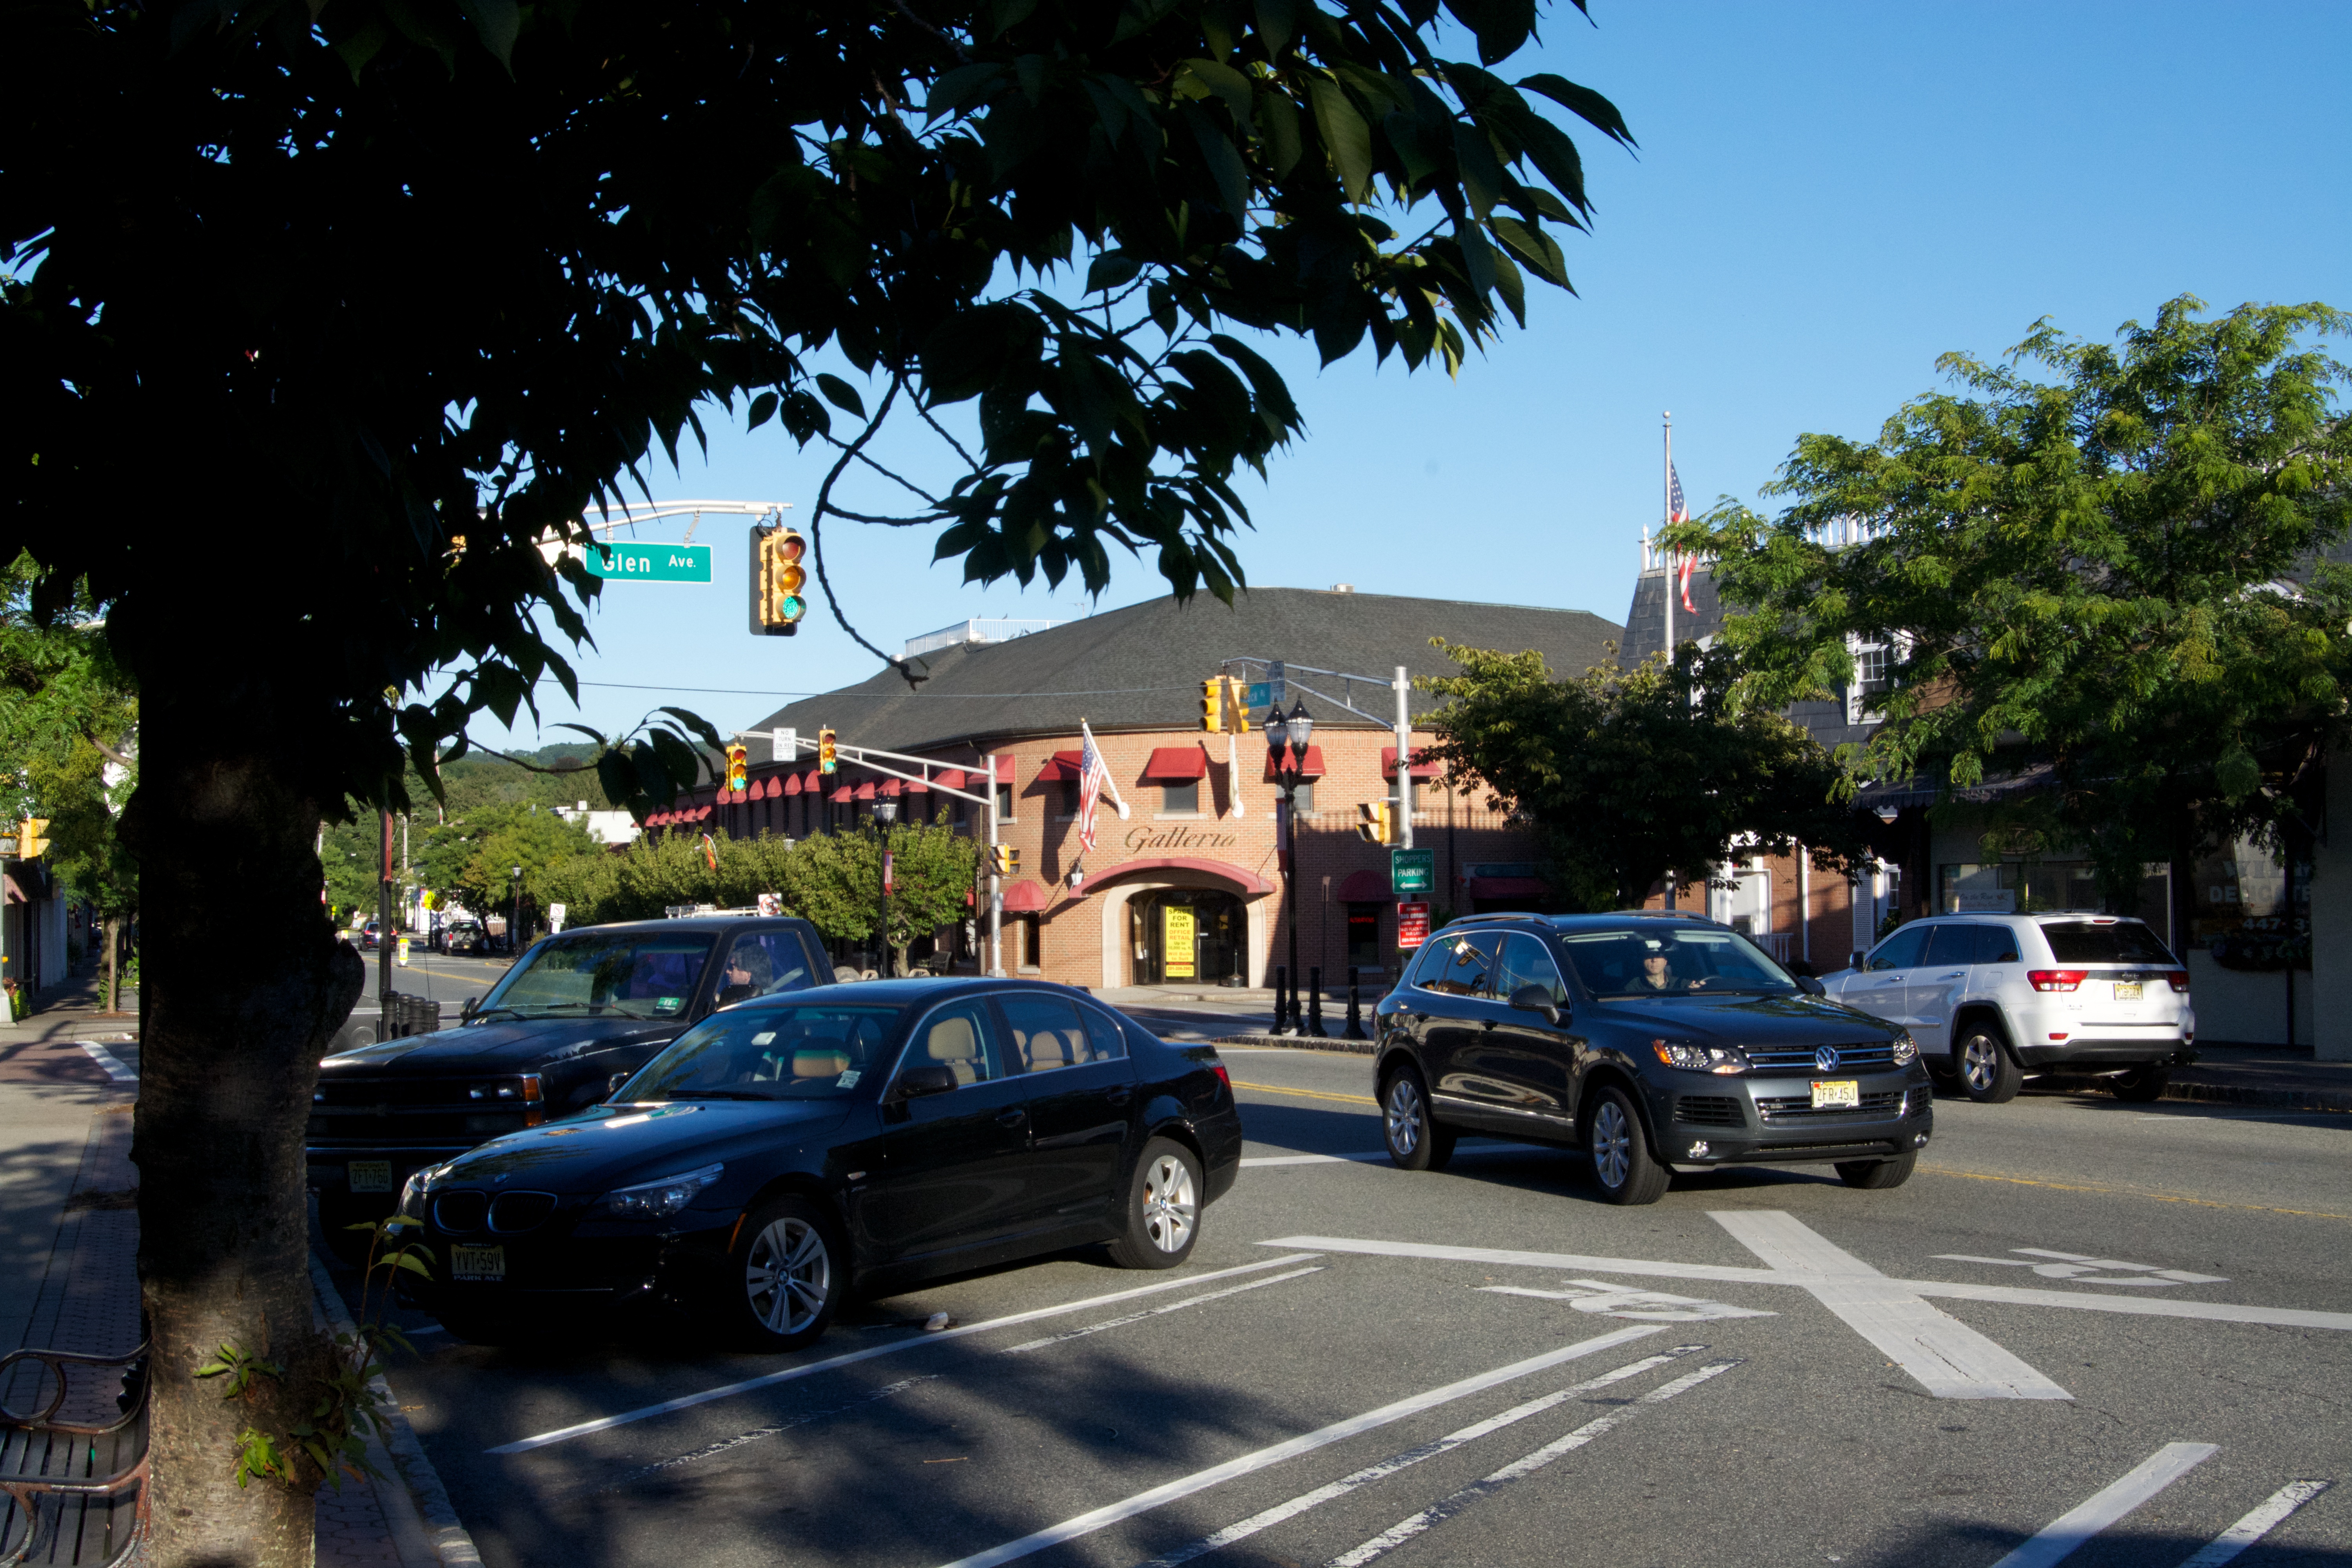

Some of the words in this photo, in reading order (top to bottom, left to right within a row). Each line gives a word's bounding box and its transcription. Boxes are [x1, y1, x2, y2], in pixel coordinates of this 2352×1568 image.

[602, 553, 650, 572] Glen
[668, 555, 695, 568] Ave.
[1123, 826, 1237, 855] Galleria
[1395, 855, 1431, 864] SHOPPERS
[1397, 867, 1429, 877] PARKING
